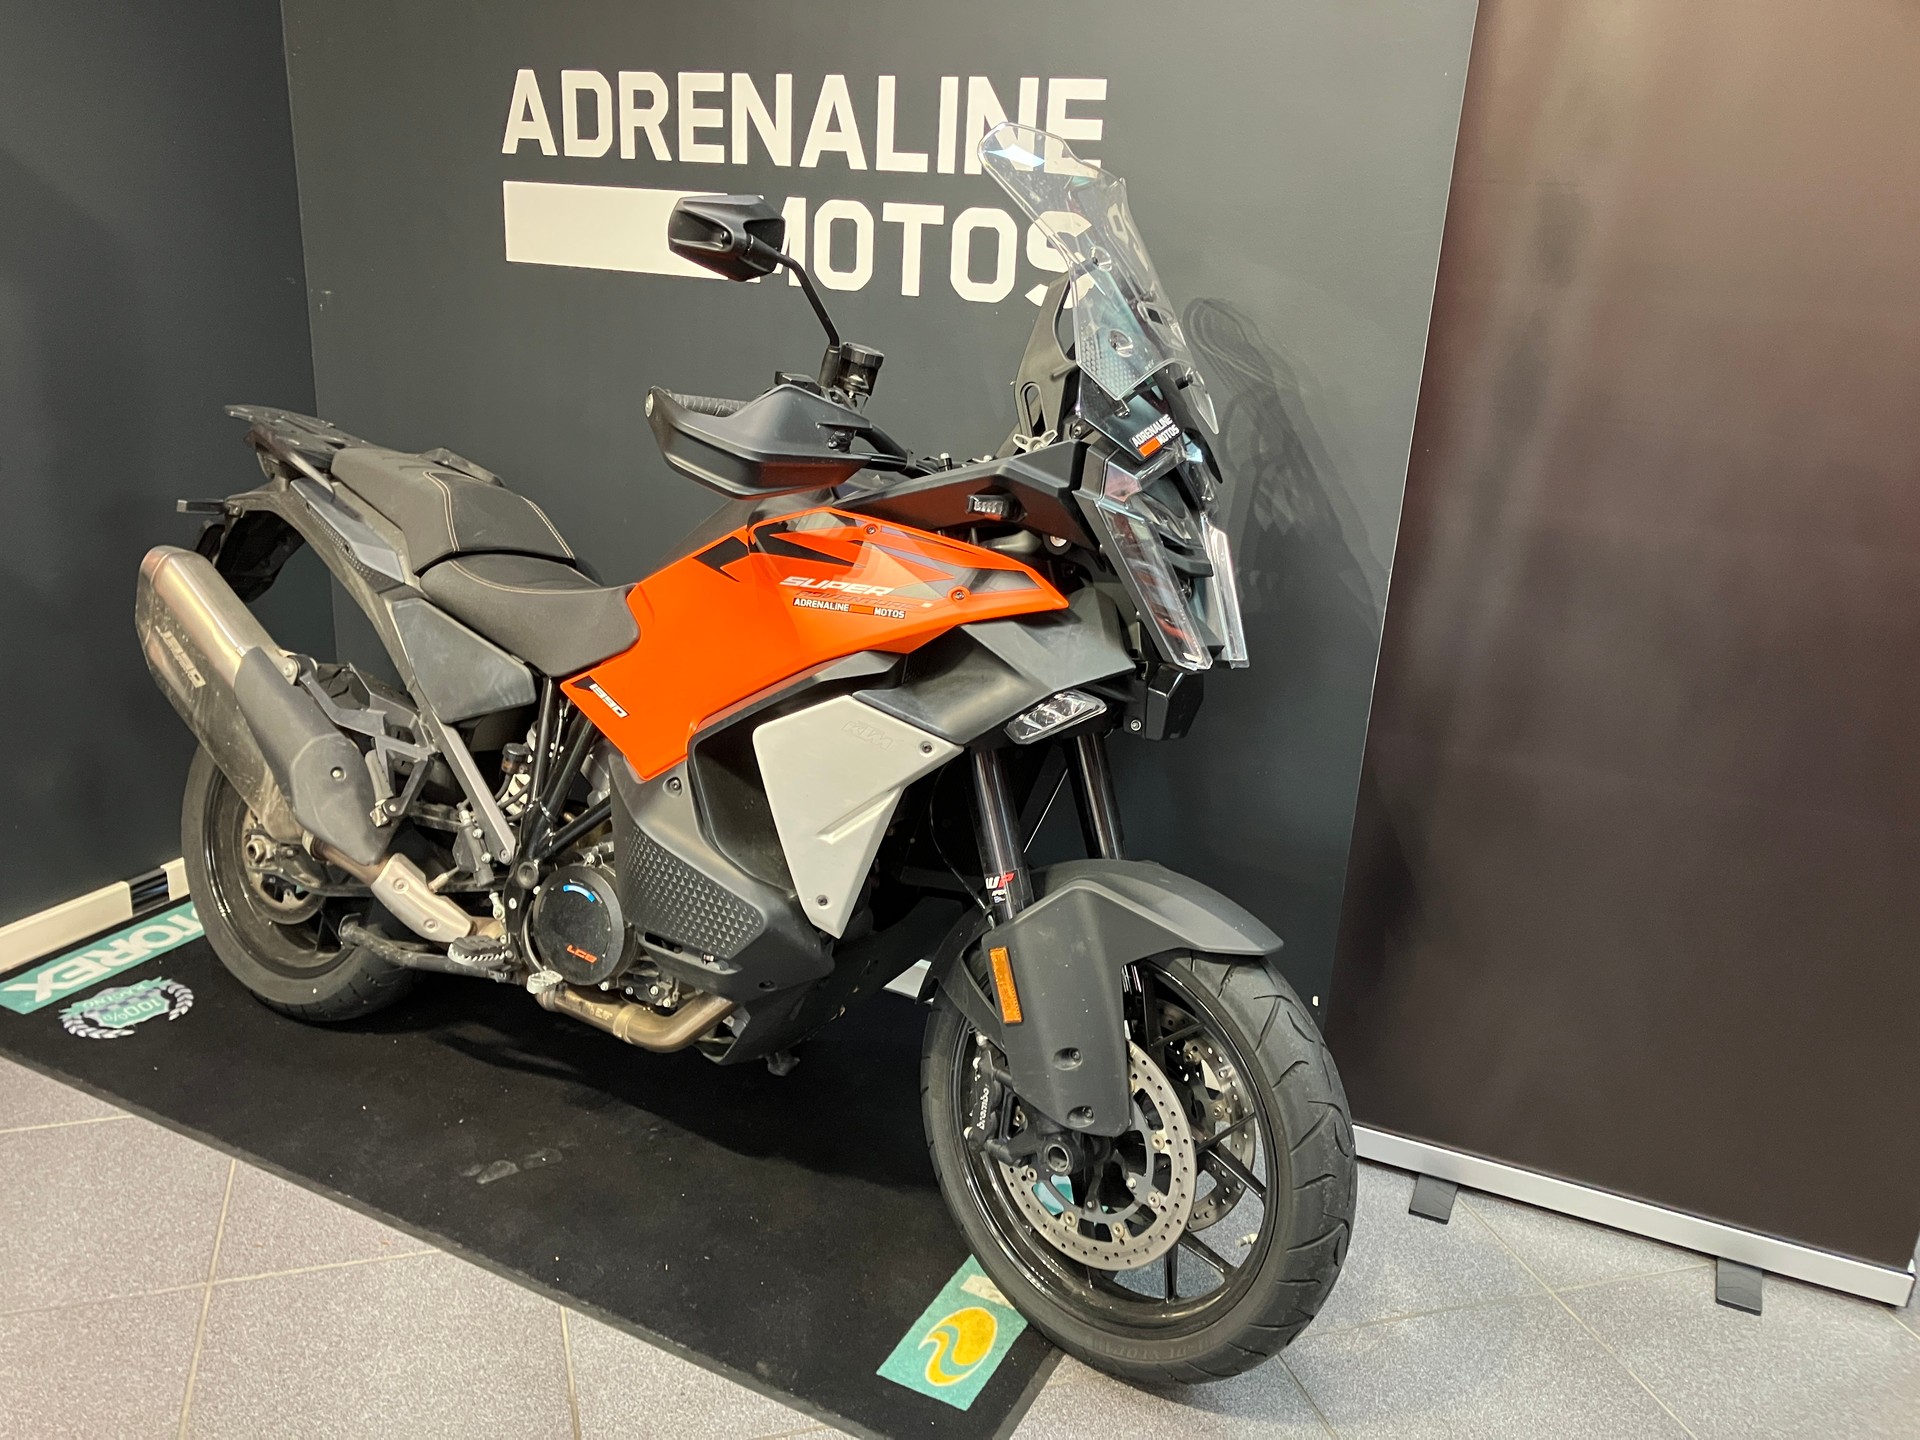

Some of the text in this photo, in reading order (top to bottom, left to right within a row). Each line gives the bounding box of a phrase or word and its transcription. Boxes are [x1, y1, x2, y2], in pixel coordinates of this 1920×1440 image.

[502, 69, 1107, 179] ADRENALINE
[1131, 413, 1173, 447] ADRENALINE
[1156, 423, 1180, 445] MOTOS
[779, 575, 895, 597] SUPER
[793, 597, 905, 619] ADRENALINE MOTOS
[985, 872, 1015, 890] WP
[3, 906, 203, 1003] TOREX
[102, 998, 162, 1023] 100%
[976, 1087, 990, 1131] brembo
